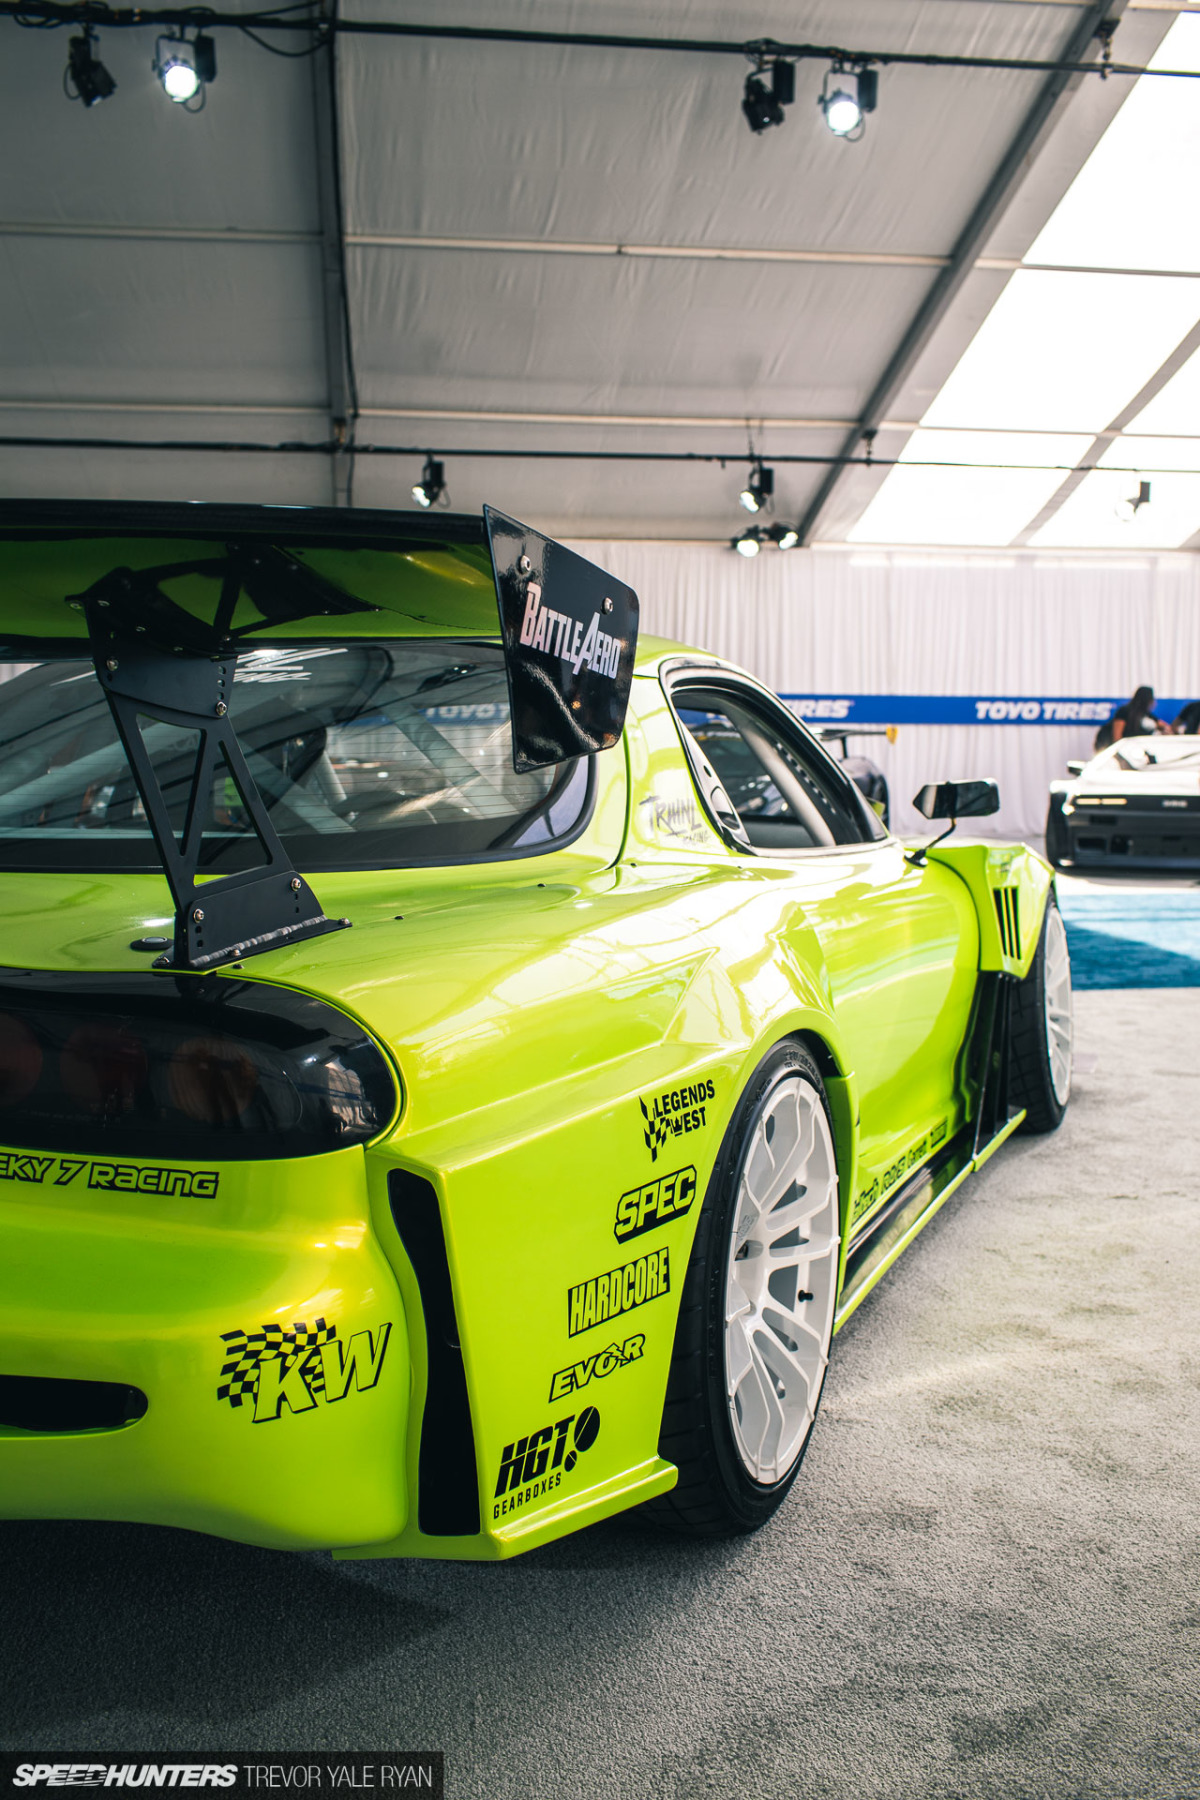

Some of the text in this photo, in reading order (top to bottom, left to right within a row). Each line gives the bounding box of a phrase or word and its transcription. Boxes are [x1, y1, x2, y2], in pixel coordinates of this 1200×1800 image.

[975, 701, 1113, 721] TOYO TIRES
[653, 1079, 716, 1119] LEGENDS
[670, 1106, 707, 1137] WEST
[53, 1158, 89, 1186] 7
[614, 1164, 697, 1244] SPEC
[568, 1246, 670, 1338] HARDCORE
[252, 1322, 393, 1424] KW
[494, 1414, 576, 1499] HGT
[493, 1471, 562, 1520] GEARBOXES
